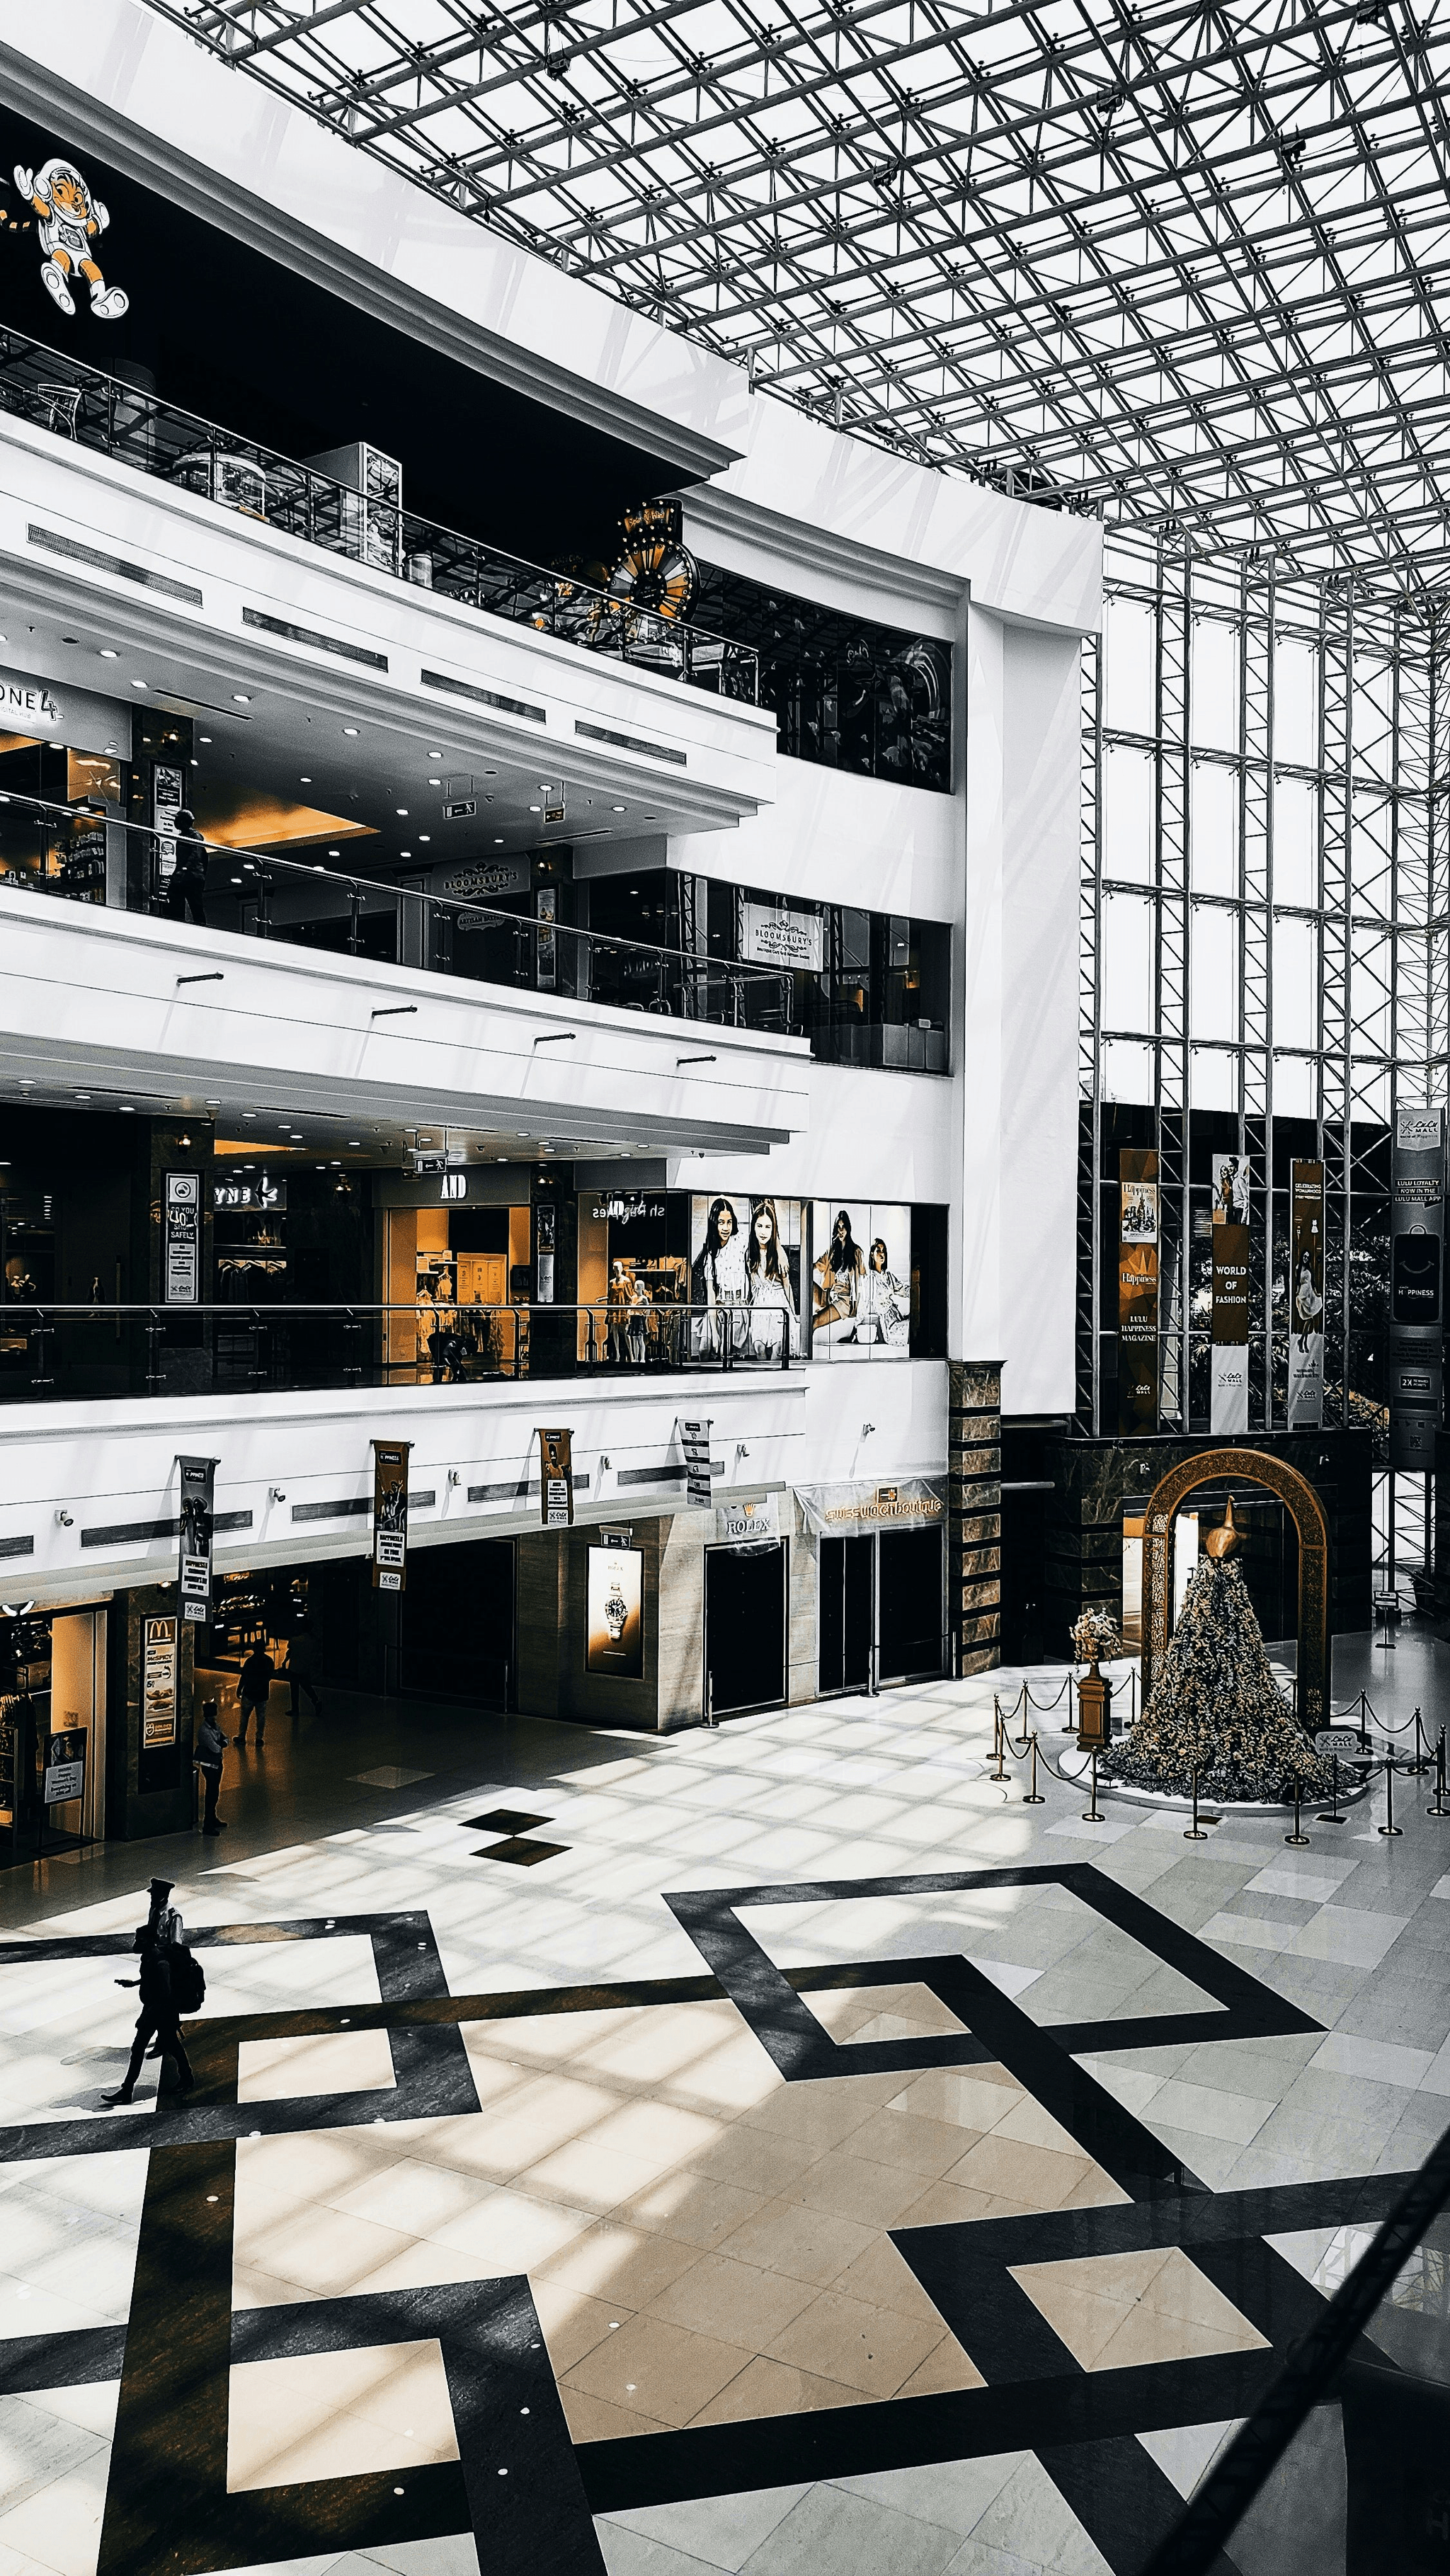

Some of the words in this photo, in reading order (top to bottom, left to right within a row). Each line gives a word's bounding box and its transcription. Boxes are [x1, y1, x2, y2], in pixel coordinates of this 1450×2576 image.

[444, 872, 518, 889] BLOOMSBURY'S
[755, 929, 812, 945] BLOOMSBURY'S
[440, 1175, 467, 1199] AND
[1122, 1272, 1157, 1285] Happiness
[1216, 1266, 1246, 1275] WORLD
[1225, 1281, 1238, 1290] OF
[726, 1518, 771, 1534] ROLEX
